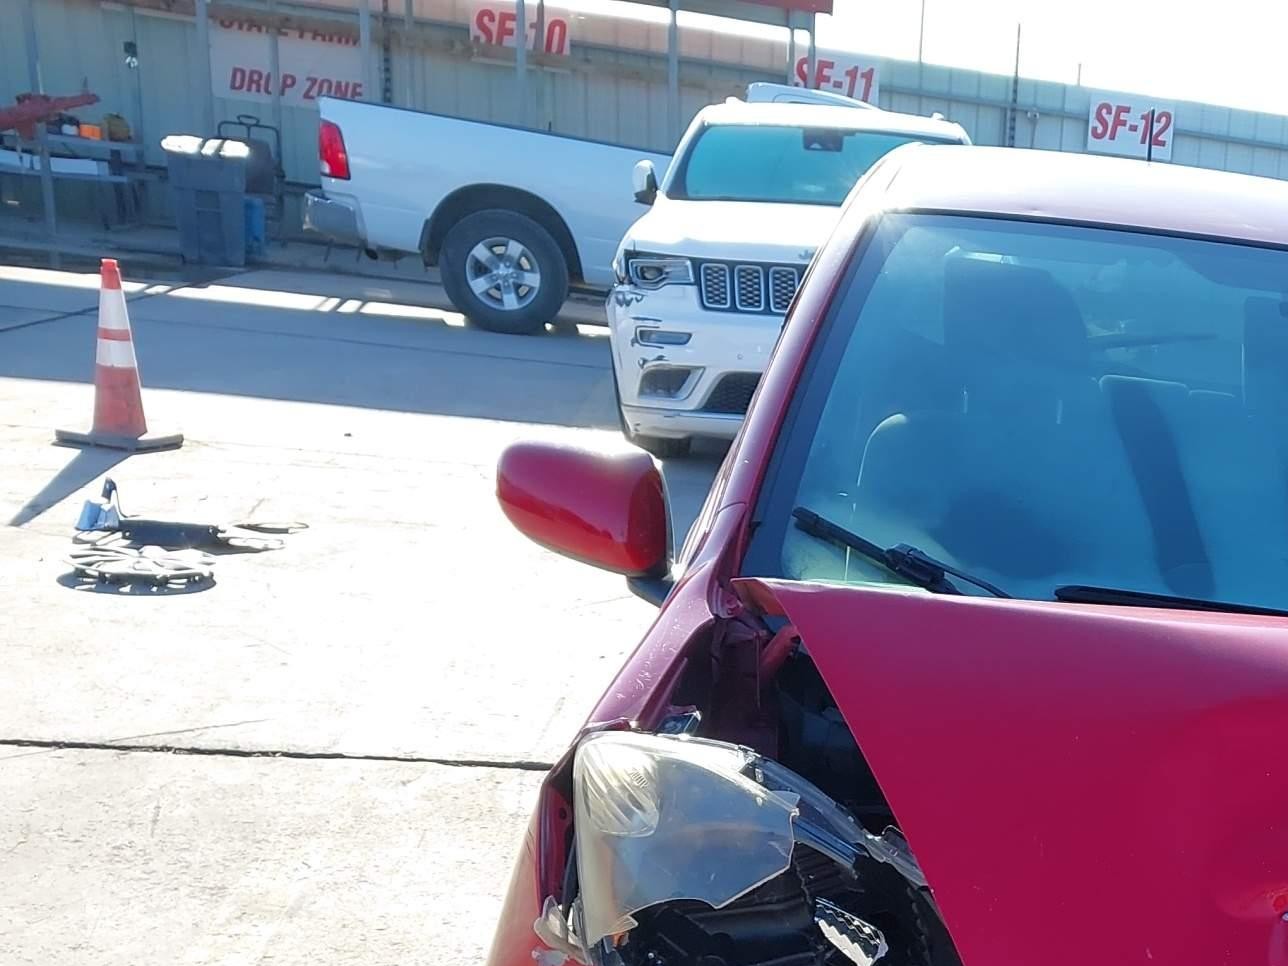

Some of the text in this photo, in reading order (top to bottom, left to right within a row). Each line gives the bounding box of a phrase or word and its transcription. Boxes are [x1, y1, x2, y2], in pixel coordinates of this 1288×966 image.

[303, 77, 363, 100] ZONE
[794, 57, 875, 103] SF-11
[1091, 103, 1172, 148] SF-12
